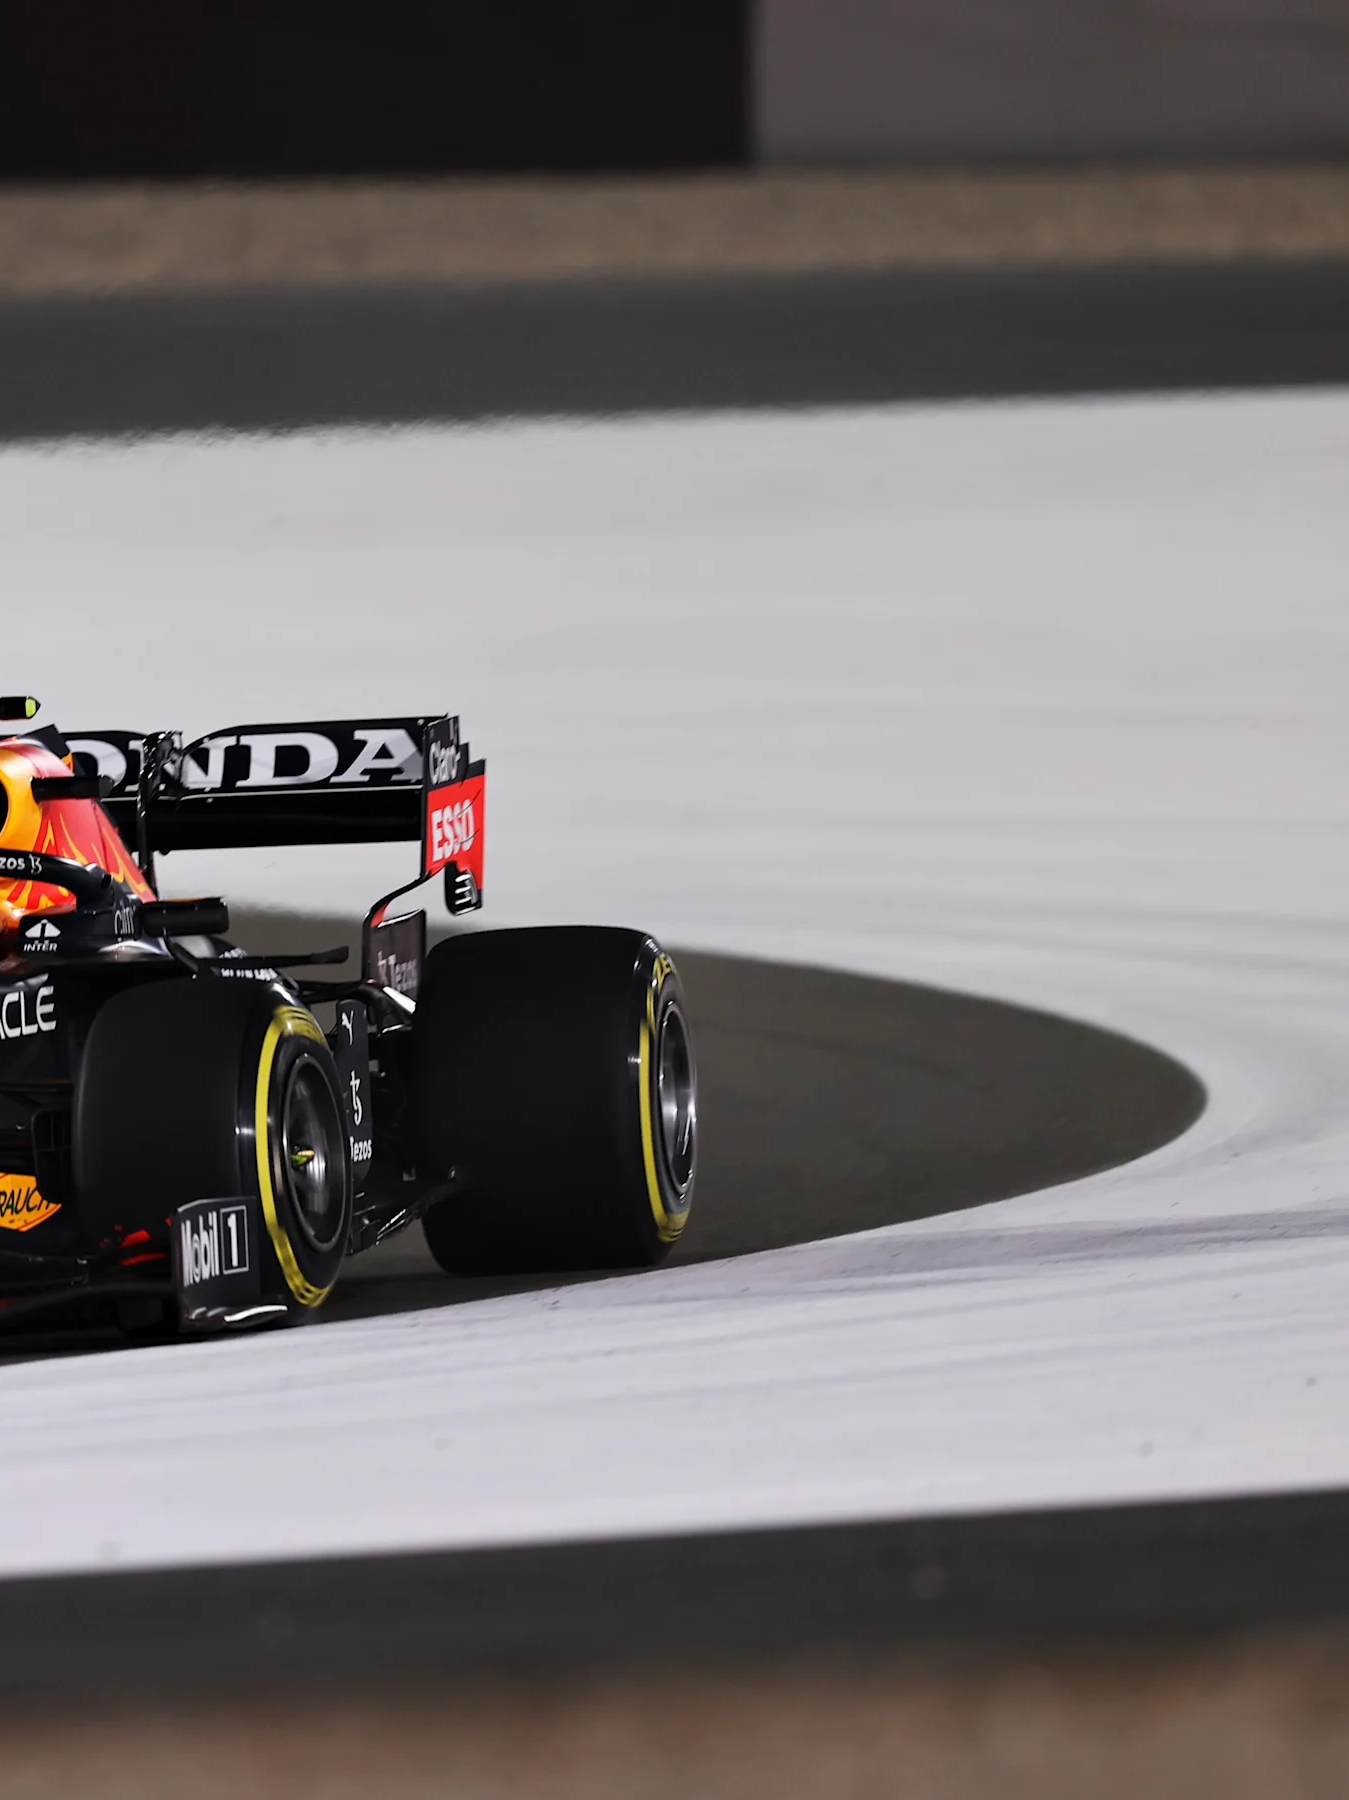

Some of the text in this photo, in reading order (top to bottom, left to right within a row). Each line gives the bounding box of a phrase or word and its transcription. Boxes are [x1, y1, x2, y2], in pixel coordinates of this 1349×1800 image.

[23, 941, 58, 953] INTER
[181, 1210, 239, 1288] Mobil 1
